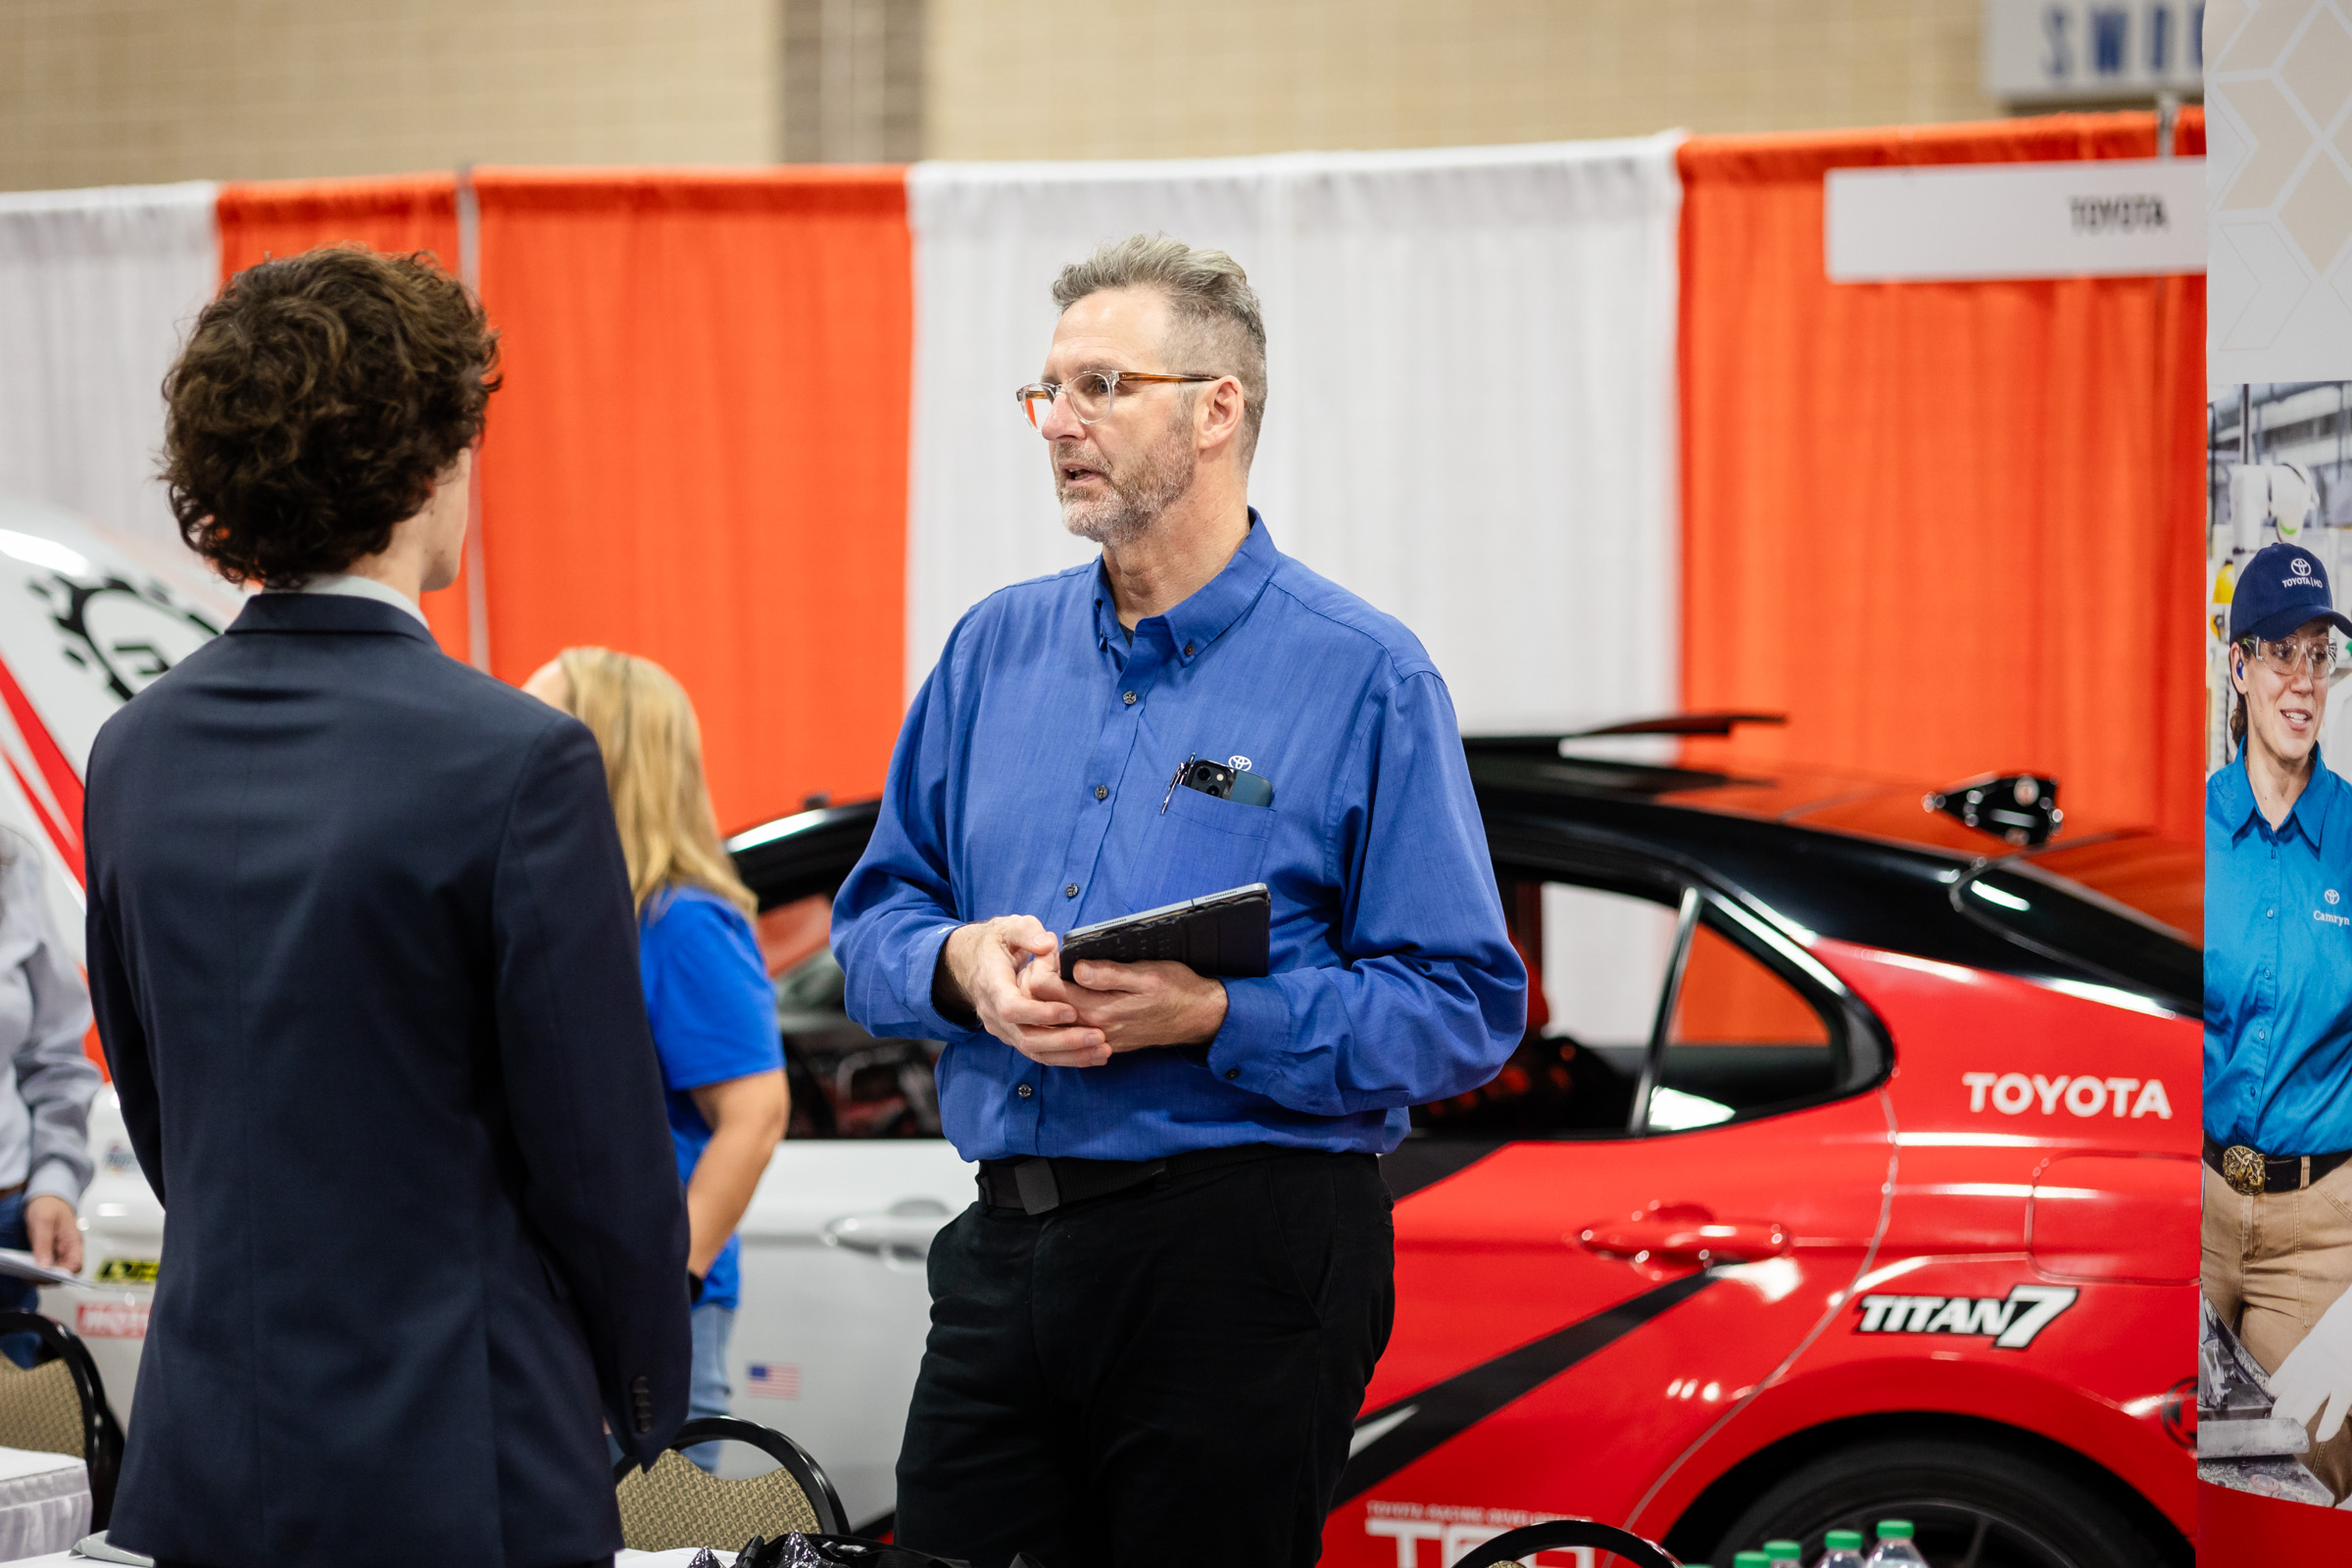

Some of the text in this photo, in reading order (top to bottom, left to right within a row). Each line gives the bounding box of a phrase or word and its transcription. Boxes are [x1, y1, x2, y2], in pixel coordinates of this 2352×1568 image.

[2069, 195, 2169, 233] TOYOTA
[2313, 909, 2350, 927] Camryn
[1961, 1071, 2173, 1119] TOYOTA
[1856, 1284, 2079, 1348] TITAN7
